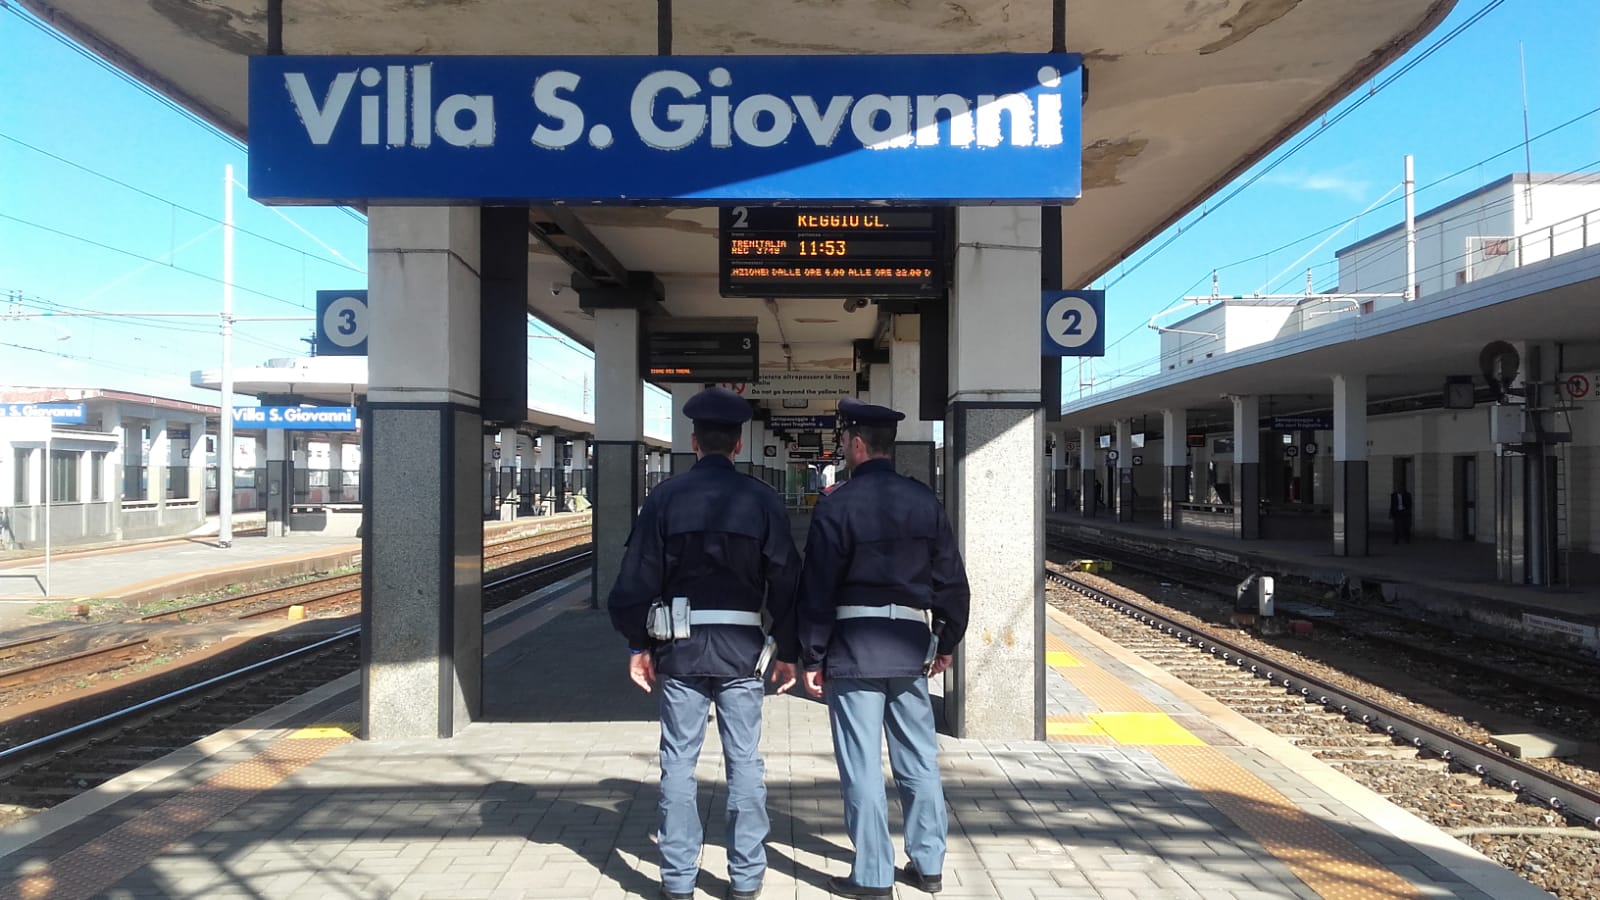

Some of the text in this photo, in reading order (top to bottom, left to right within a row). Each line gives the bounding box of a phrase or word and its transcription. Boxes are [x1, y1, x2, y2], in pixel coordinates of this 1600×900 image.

[283, 65, 1064, 151] Villa S. Giovanni
[730, 206, 749, 229] 2
[731, 239, 787, 248] TRENITALIA
[799, 240, 846, 256] 11:53
[771, 268, 801, 277] DALLE
[804, 268, 822, 277] ORE
[847, 268, 872, 277] ALLE
[874, 268, 893, 277] ORE
[338, 308, 357, 336] 3
[1061, 308, 1082, 336] 2
[742, 337, 751, 350] 3
[782, 388, 805, 396] beyond
[817, 388, 837, 396] yellow
[22, 404, 82, 417] Giovanni
[232, 407, 352, 422] Villa S. Giovanni
